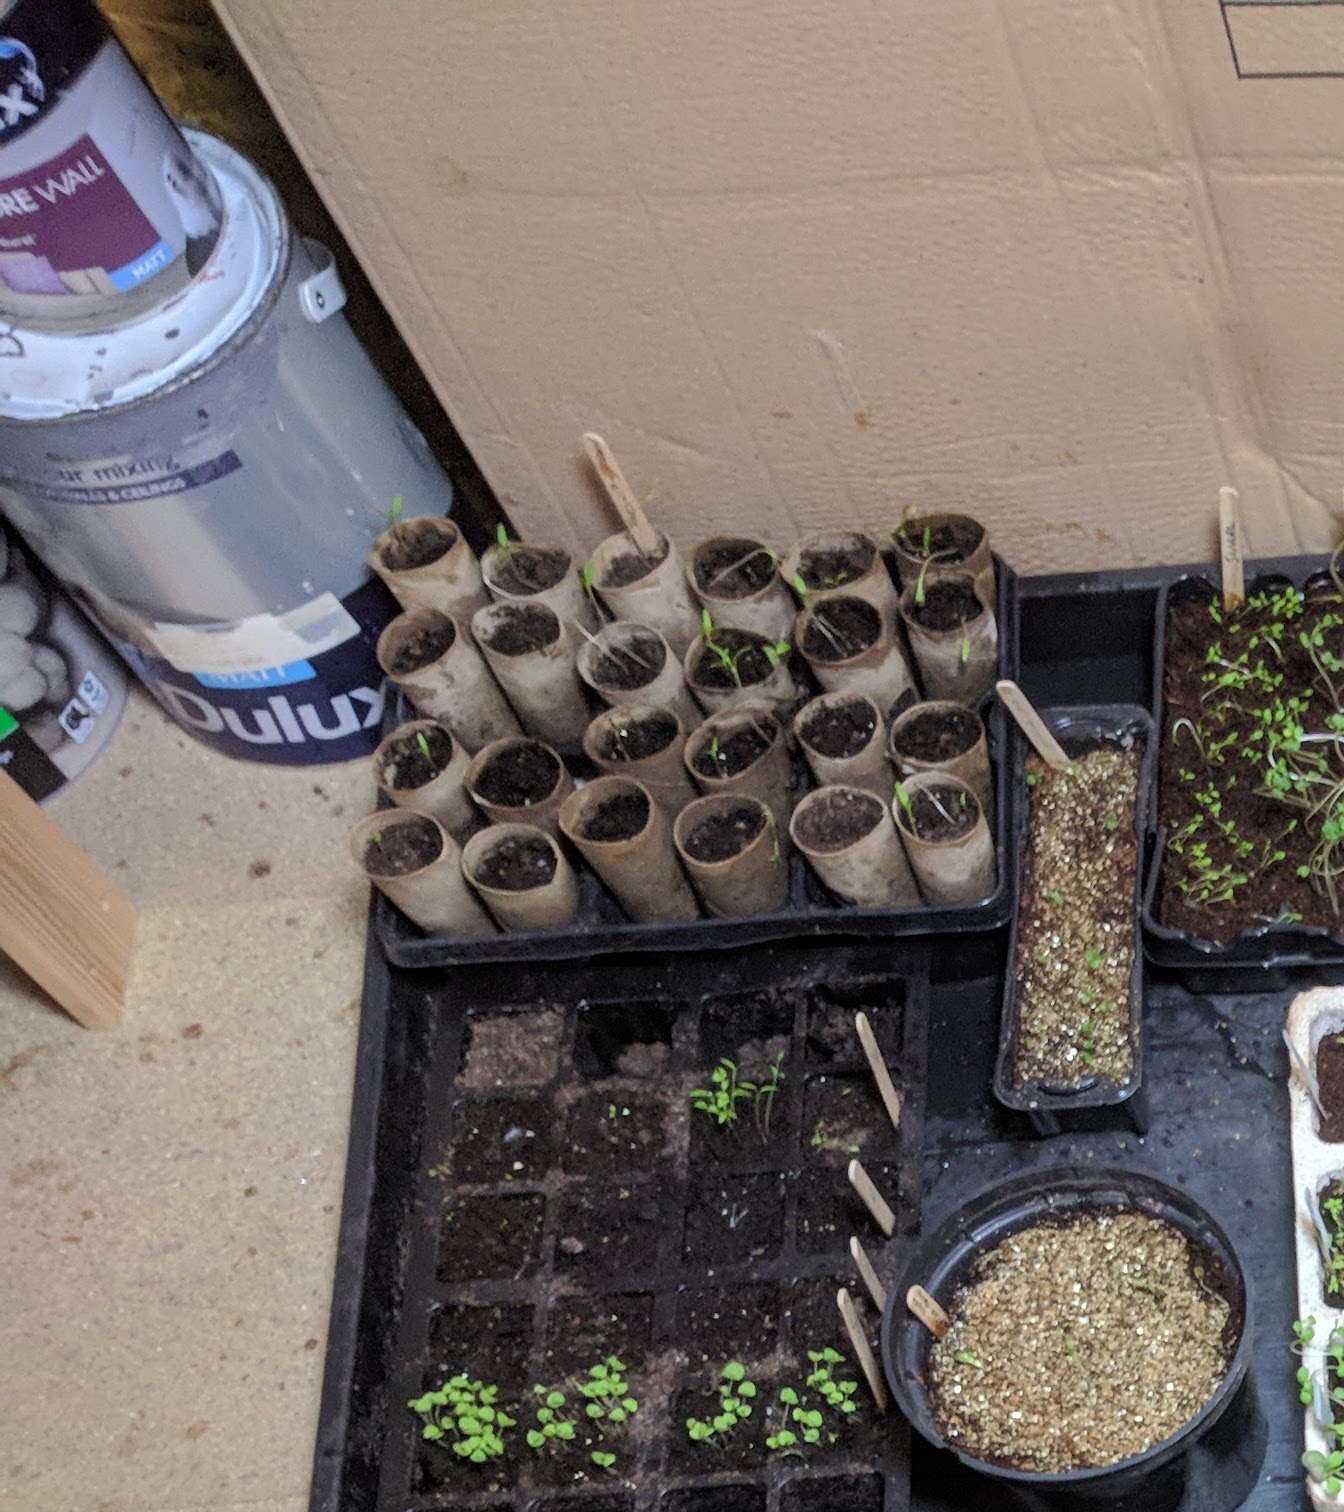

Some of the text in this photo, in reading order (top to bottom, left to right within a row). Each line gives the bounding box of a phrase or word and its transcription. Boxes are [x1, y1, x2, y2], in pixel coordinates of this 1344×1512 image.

[0, 155, 105, 218] RE WALL
[131, 250, 167, 280] MATT
